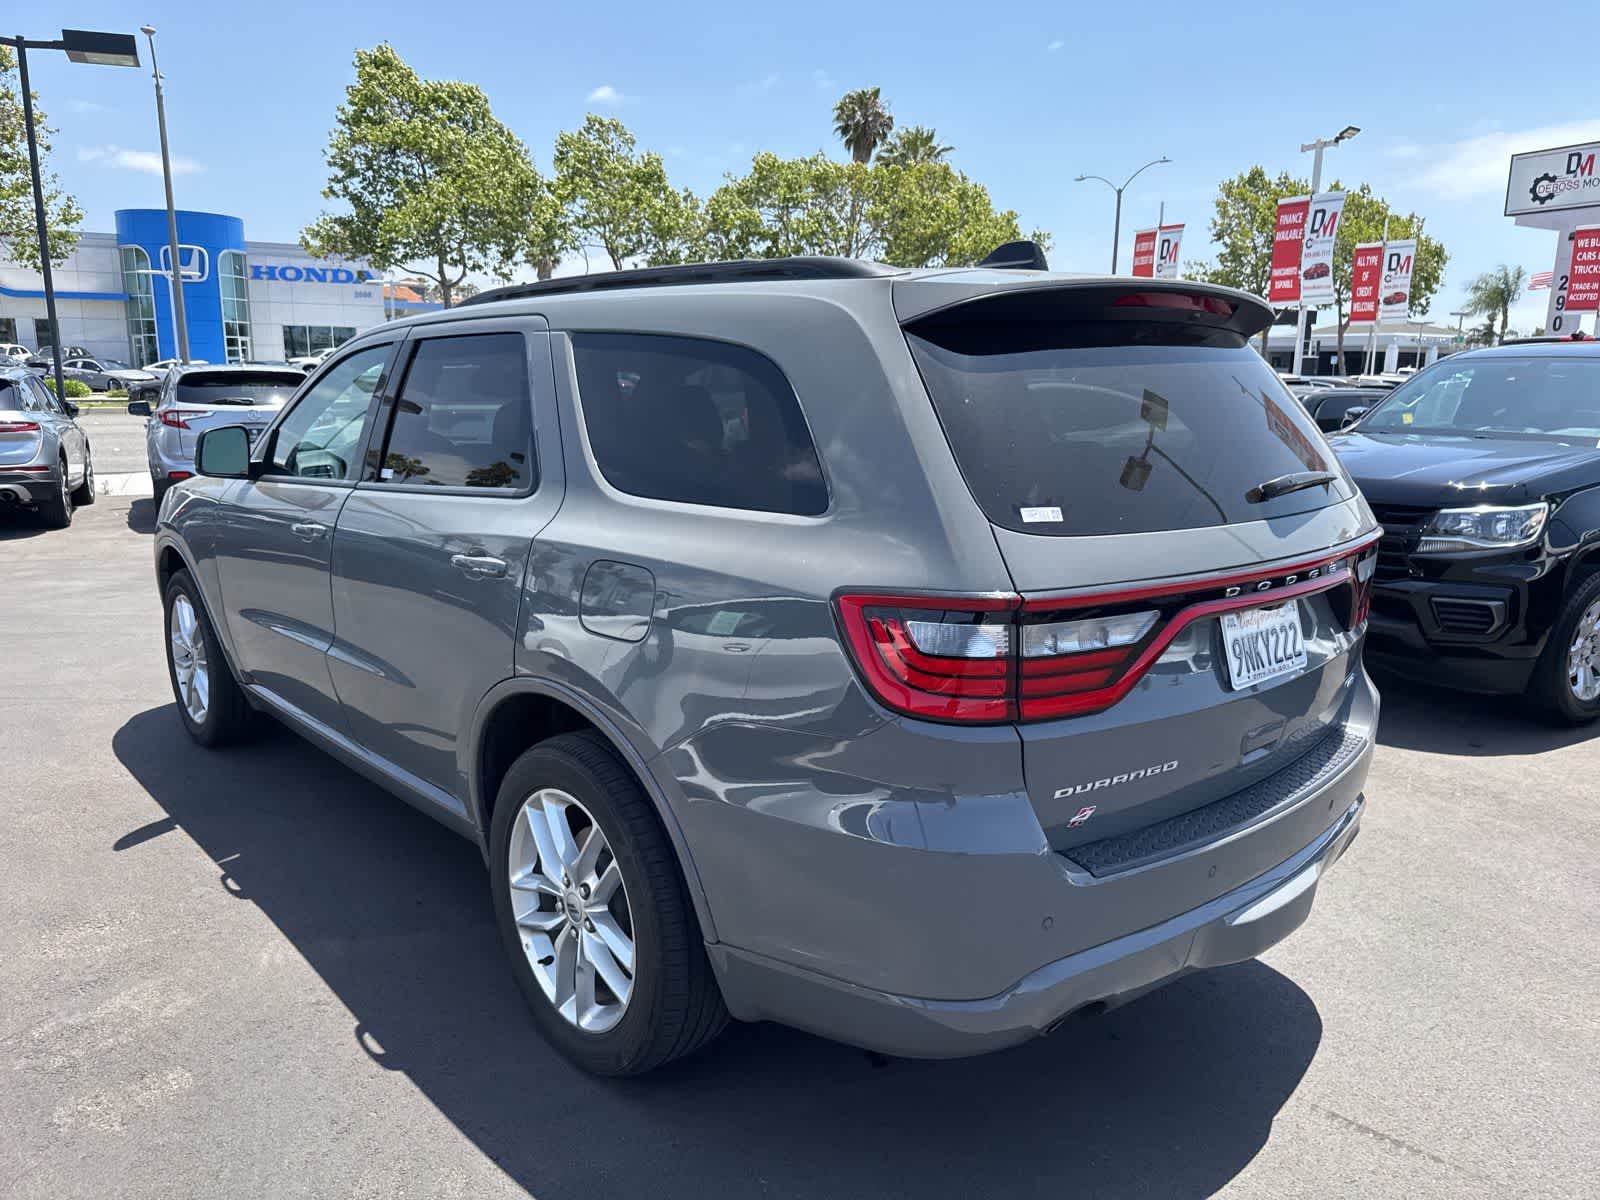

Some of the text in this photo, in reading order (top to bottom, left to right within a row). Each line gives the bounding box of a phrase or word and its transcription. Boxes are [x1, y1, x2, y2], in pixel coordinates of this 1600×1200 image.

[1538, 180, 1579, 194] DEBOSS
[1280, 212, 1303, 225] FINANCE
[1275, 228, 1303, 241] AVAILABLE
[1577, 238, 1590, 248] WE
[1357, 255, 1378, 267] ALL TYPE
[1576, 251, 1597, 262] CARS
[250, 264, 375, 284] HONDA
[1362, 271, 1369, 282] OF
[1356, 286, 1373, 297] CREDIT
[1571, 282, 1599, 291] TRADE-IN
[1568, 292, 1598, 301] ACCEPTED
[1352, 301, 1375, 312] WELCOME
[1225, 561, 1337, 597] DODGE
[1232, 622, 1302, 678] 9NKY222
[1053, 760, 1179, 800] DURANGO
